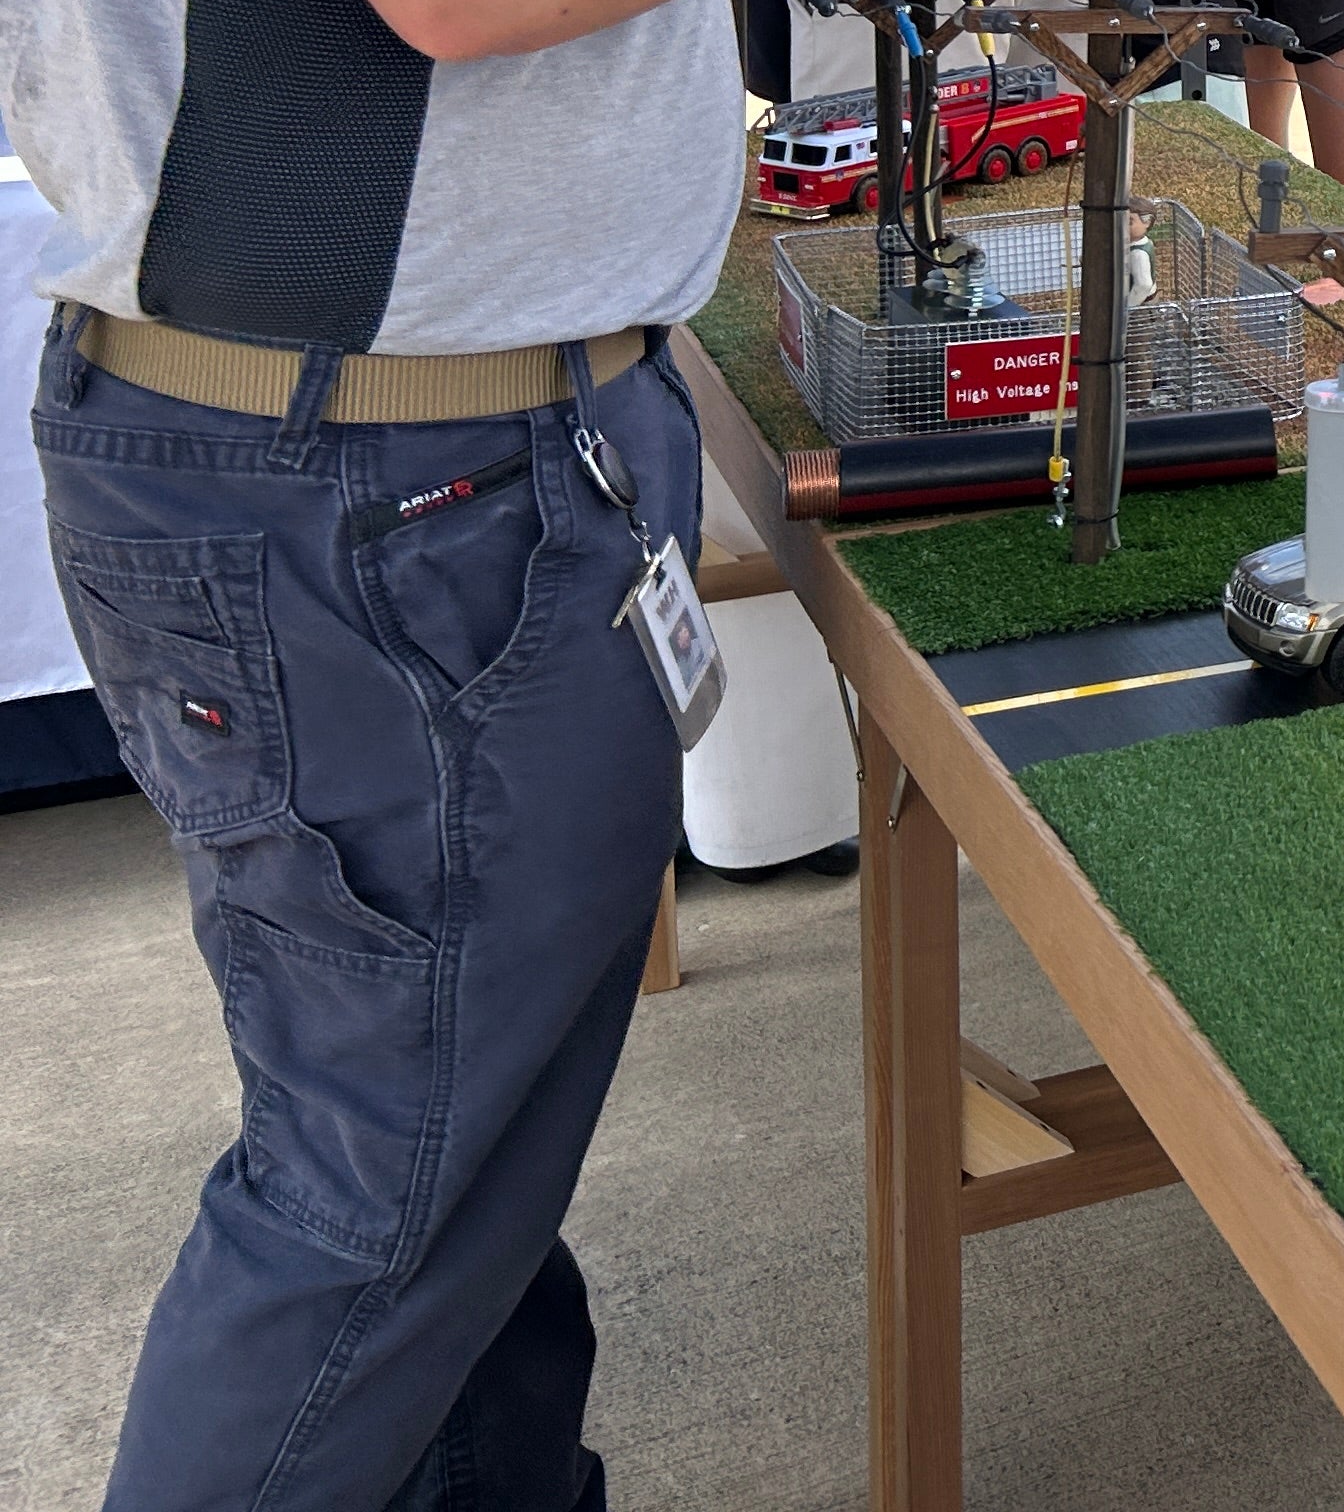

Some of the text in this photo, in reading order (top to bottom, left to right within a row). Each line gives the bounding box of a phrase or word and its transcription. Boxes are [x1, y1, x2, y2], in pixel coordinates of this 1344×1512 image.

[993, 351, 1060, 371] DANGER
[955, 387, 989, 404] High
[996, 383, 1051, 399] Voltage
[399, 485, 453, 512] ARIAT
